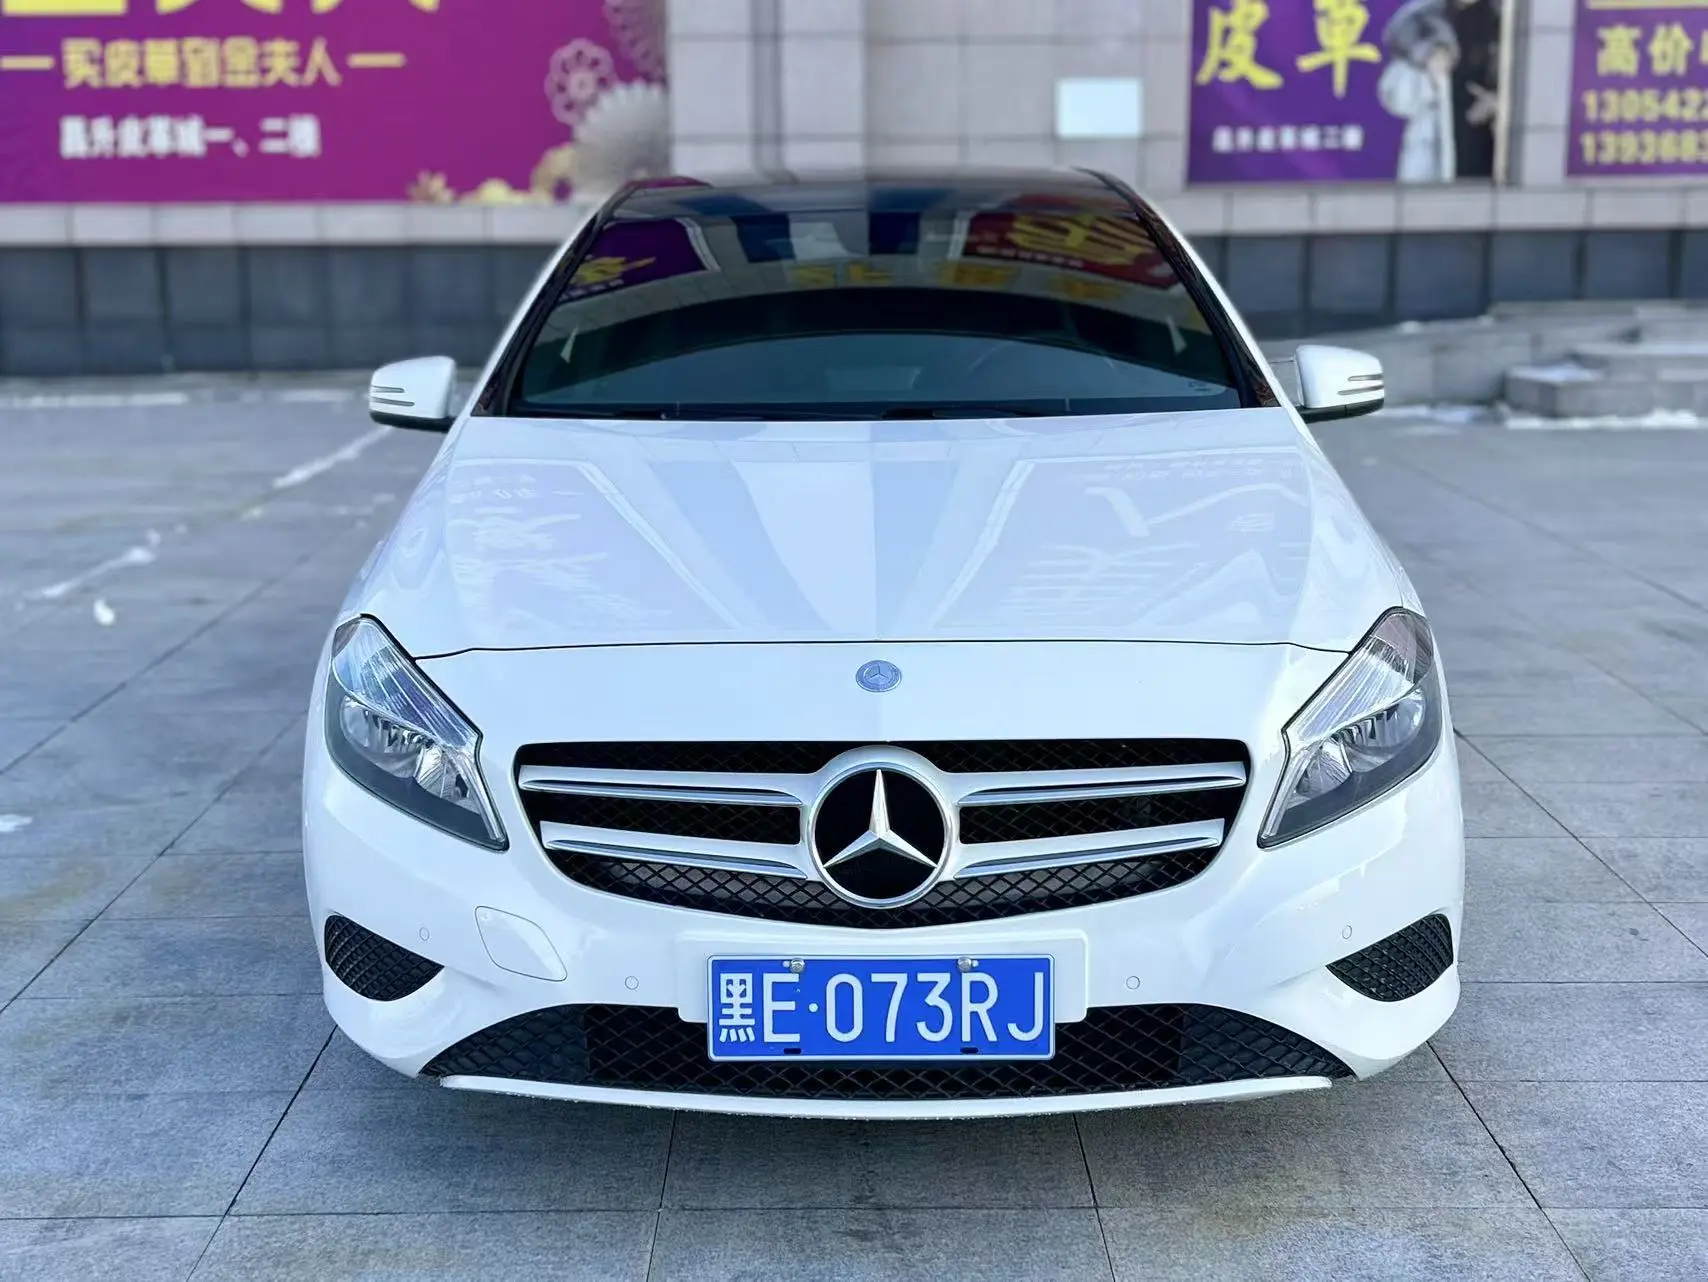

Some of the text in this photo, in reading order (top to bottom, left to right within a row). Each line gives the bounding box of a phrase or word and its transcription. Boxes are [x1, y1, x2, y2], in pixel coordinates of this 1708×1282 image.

[1196, 0, 1381, 99] 皮草
[1597, 24, 1708, 76] 高价
[719, 972, 1044, 1043] 黑E·073RJ
